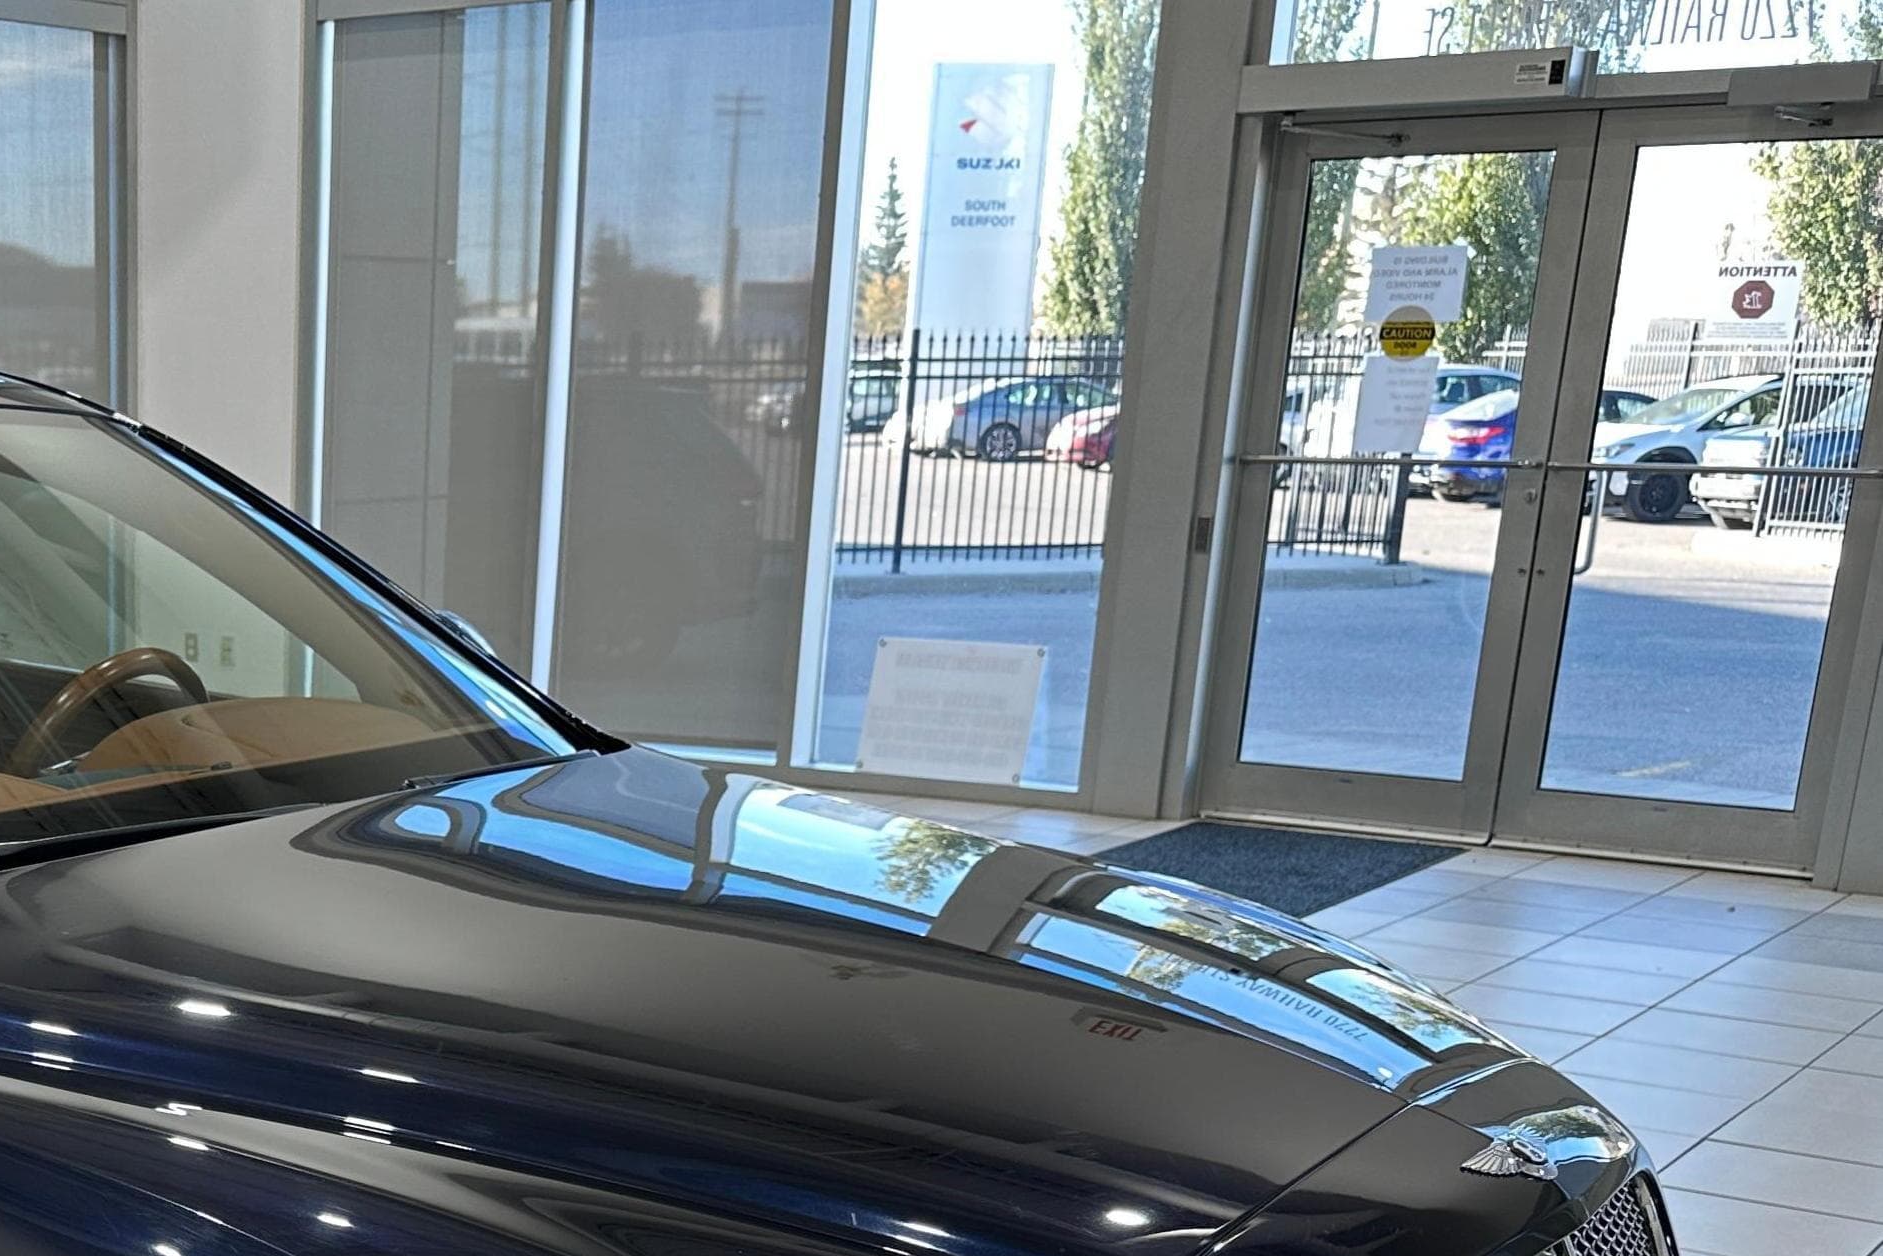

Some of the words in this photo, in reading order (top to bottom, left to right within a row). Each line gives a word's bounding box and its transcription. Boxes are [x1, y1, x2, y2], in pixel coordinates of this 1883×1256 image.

[964, 199, 1006, 211] SOUTH
[950, 215, 1015, 227] DEERFOOT
[1381, 329, 1433, 338] CAUTION
